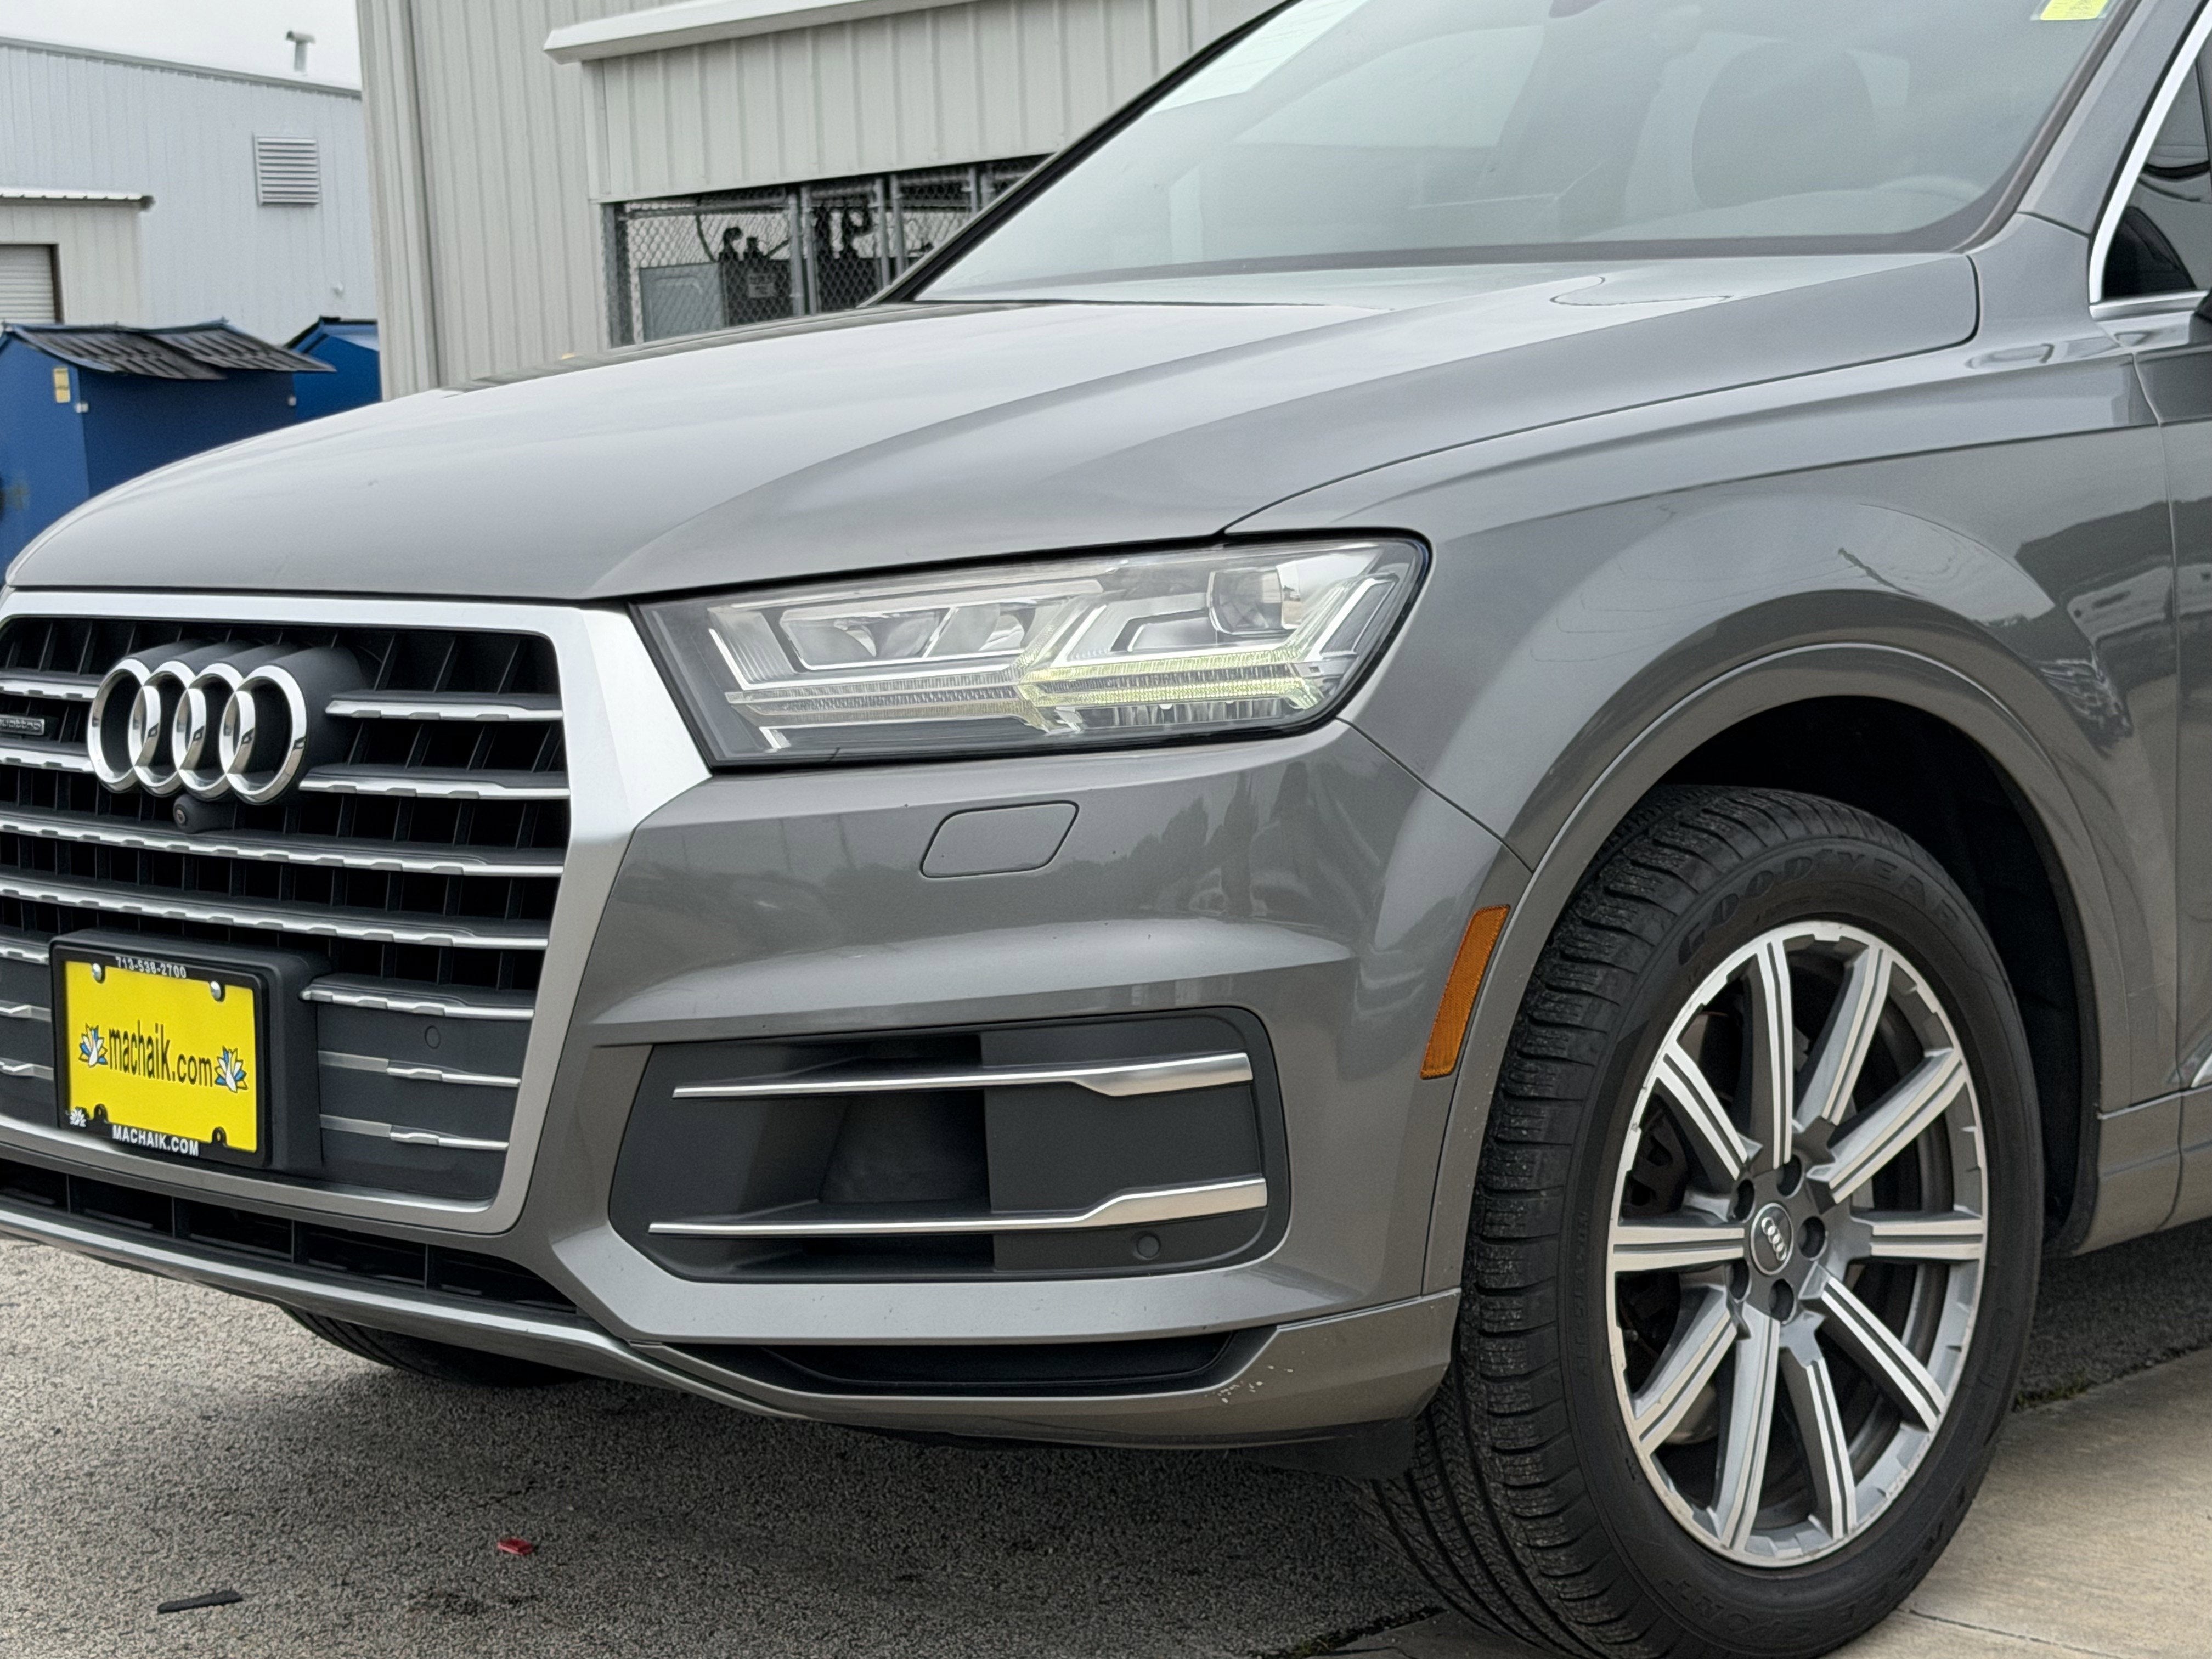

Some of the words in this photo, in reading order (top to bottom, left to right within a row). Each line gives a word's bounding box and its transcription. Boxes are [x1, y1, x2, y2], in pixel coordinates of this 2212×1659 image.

[115, 956, 187, 979] 713-538-2700
[109, 1019, 213, 1087] machaik.com
[112, 1125, 199, 1156] MACHAIK.COM
